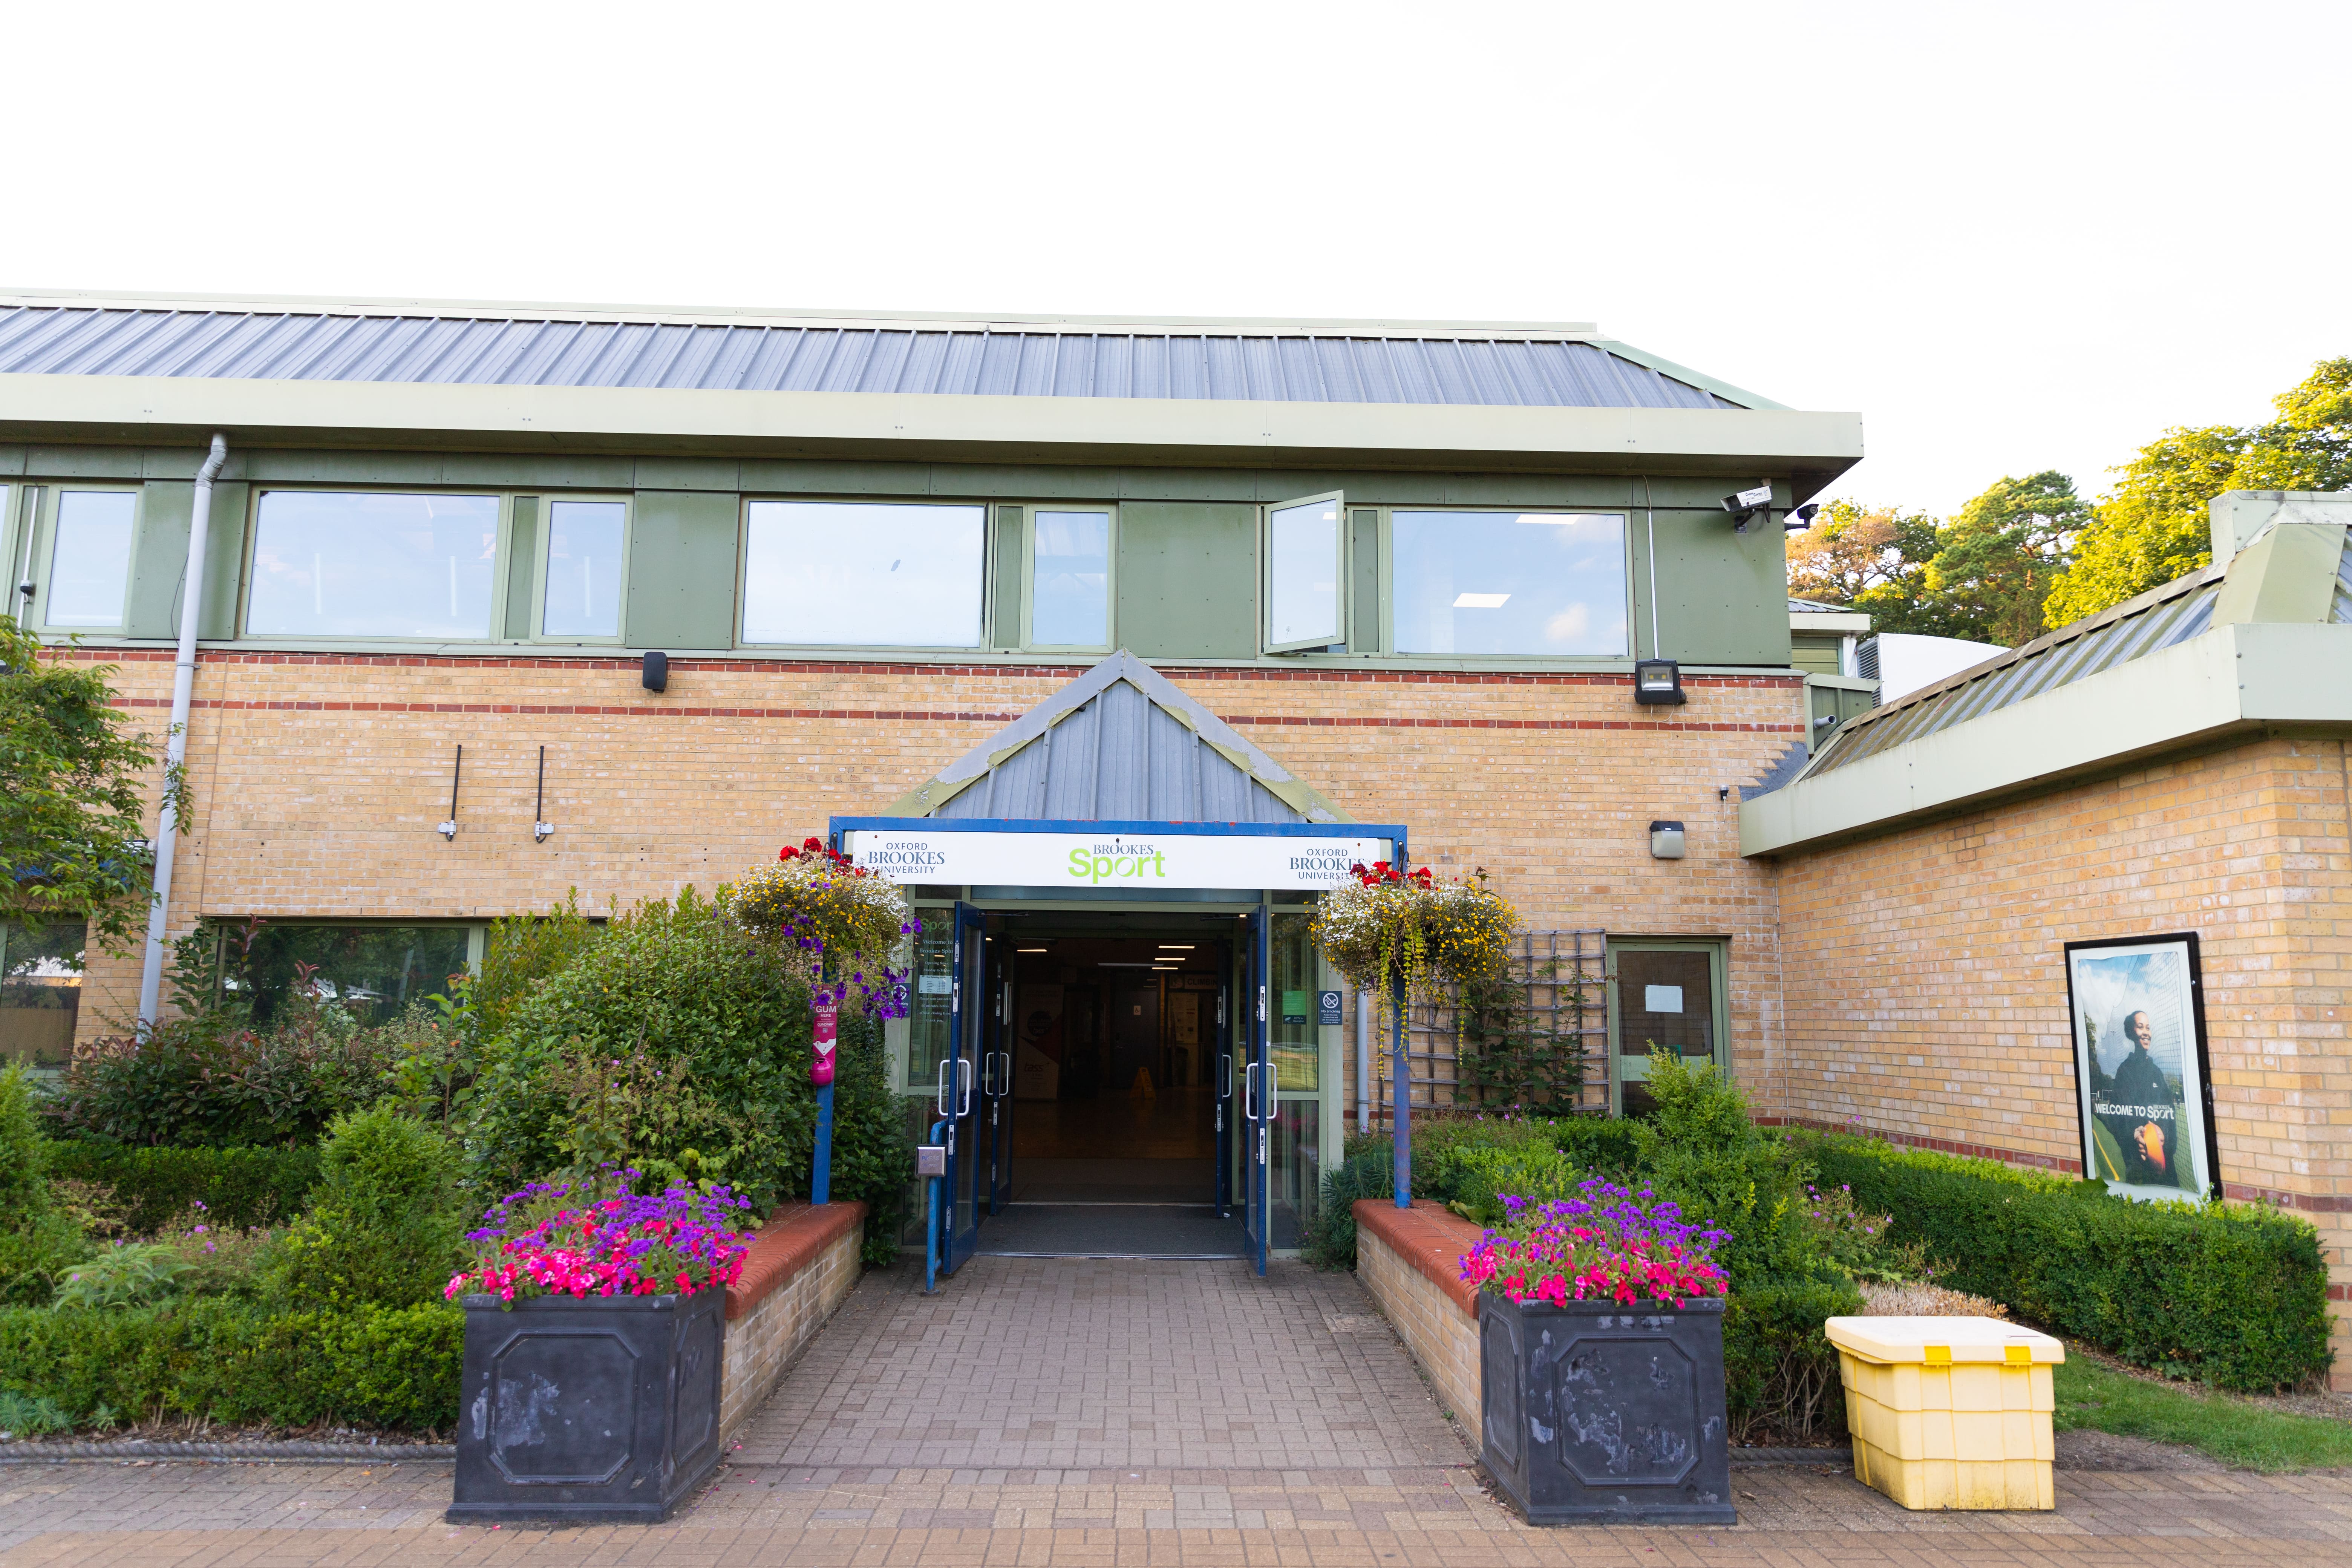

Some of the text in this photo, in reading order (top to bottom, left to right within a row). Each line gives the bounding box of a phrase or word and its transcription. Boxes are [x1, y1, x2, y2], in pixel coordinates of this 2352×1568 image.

[1093, 844, 1153, 854] BROOKES
[868, 851, 945, 864] BROOKES
[1068, 848, 1165, 884] Sport
[921, 918, 954, 933] Spor
[1024, 1062, 1044, 1072] tass
[2095, 1103, 2174, 1121] WELCOME TO Sport
